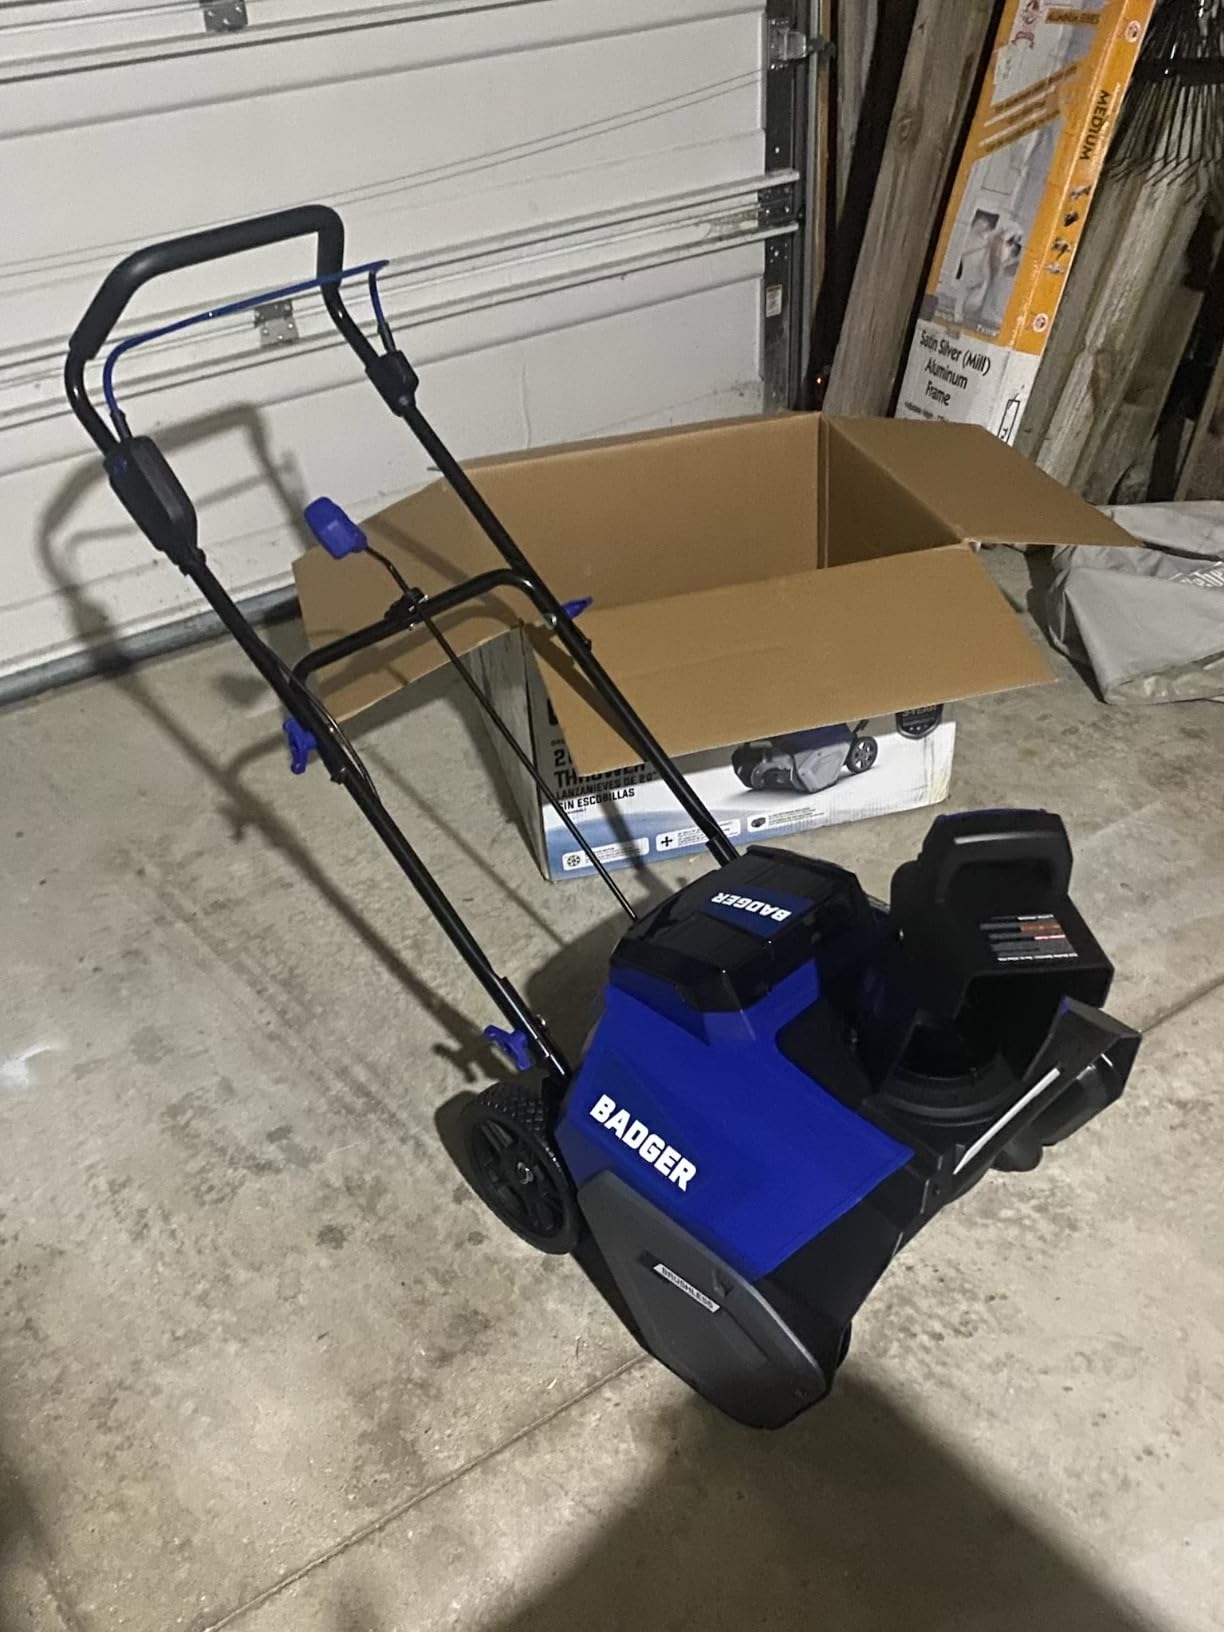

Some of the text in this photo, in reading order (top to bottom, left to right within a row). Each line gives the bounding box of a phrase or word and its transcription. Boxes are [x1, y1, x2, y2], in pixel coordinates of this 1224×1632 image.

[1080, 90, 1110, 160] MEDIUM
[920, 330, 991, 376] Satin Silver (Mill)
[925, 357, 968, 389] Aluminum
[925, 380, 951, 406] Frame
[556, 778, 620, 800] LANZANIEVES
[624, 776, 637, 786] DE
[578, 788, 635, 808] ESCOBILLAS
[711, 892, 792, 921] BADGER
[589, 1093, 697, 1192] BADGER
[662, 1267, 713, 1308] BRUSHLESS
